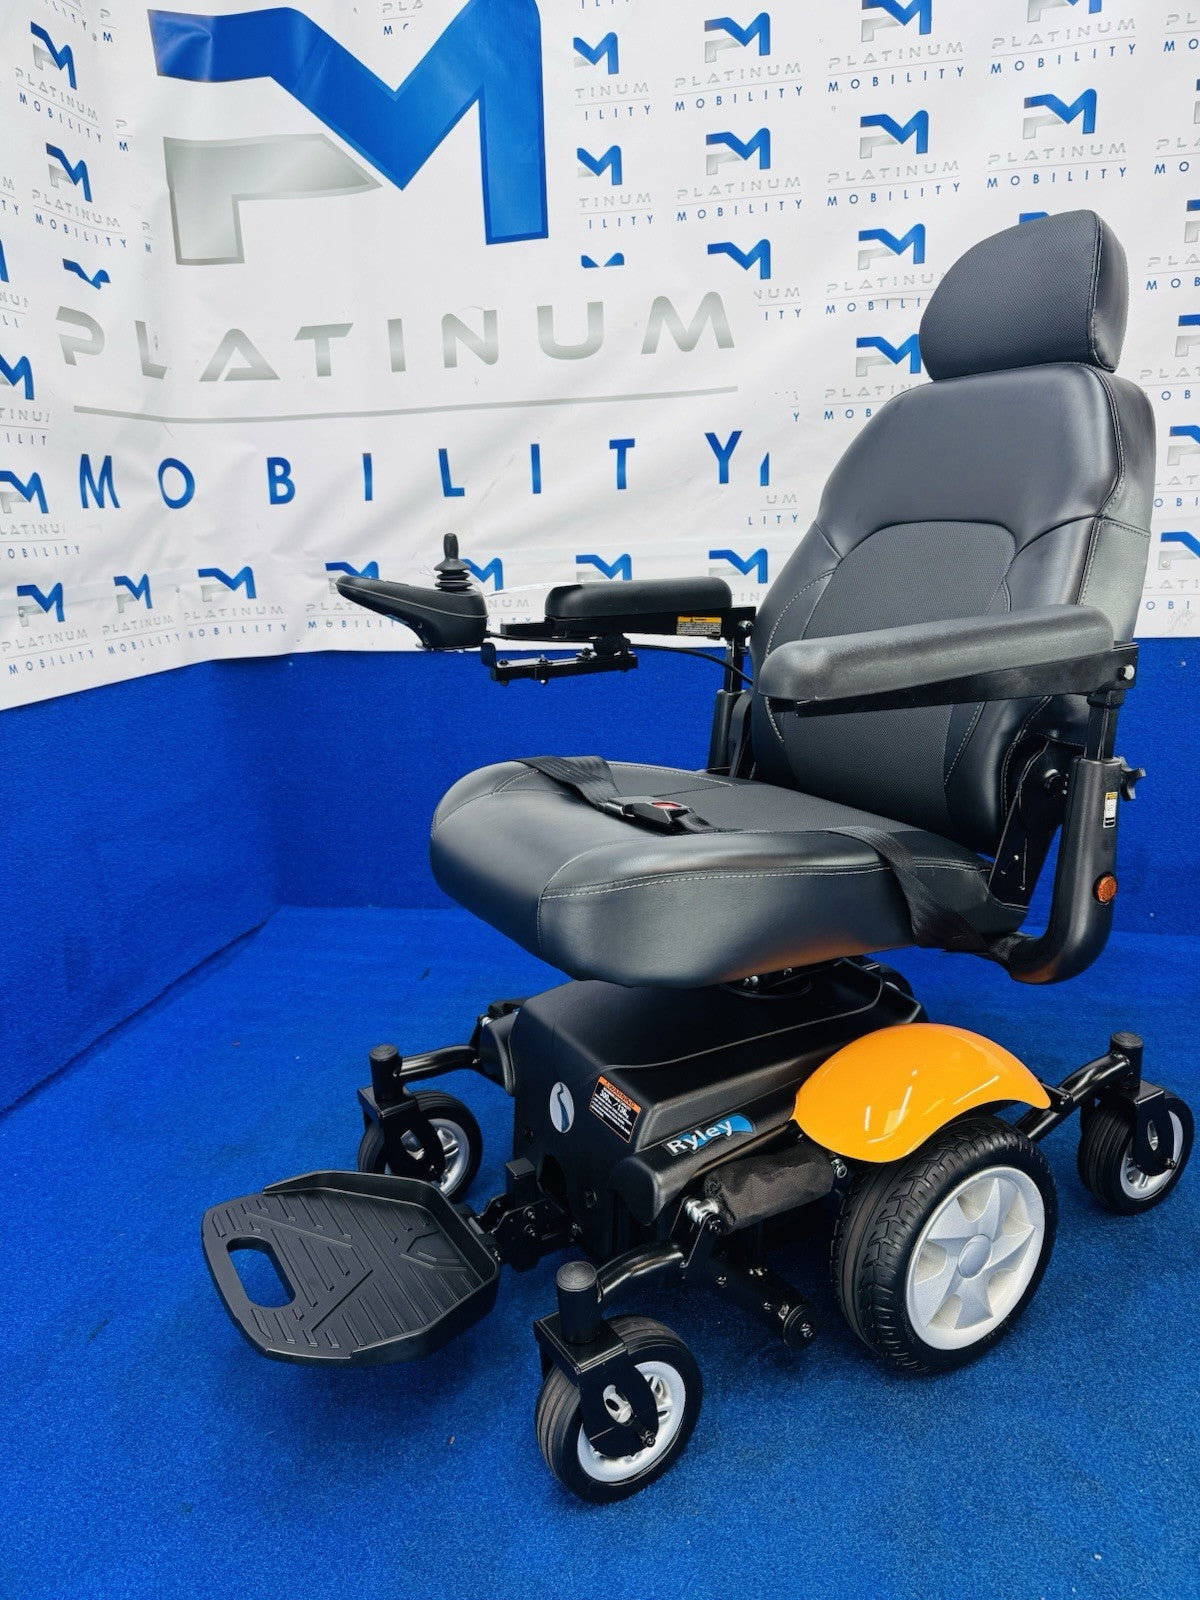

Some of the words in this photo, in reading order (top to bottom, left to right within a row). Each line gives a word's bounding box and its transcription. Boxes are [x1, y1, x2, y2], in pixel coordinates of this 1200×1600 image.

[991, 17, 1136, 50] PLATINUM
[828, 41, 964, 69] PLATINUM
[990, 44, 1137, 74] MOBILITY
[674, 62, 802, 88] PLATINUM
[828, 66, 964, 92] MOBILITY
[15, 67, 98, 121] PLATINUM
[575, 81, 649, 99] TINUM
[674, 86, 803, 111] MOBILITY
[19, 92, 101, 143] MOBILITY
[585, 105, 651, 121] ILITY
[988, 142, 1127, 165] PLATINUM
[827, 160, 960, 183] PLATINUM
[986, 166, 1127, 188] MOBILITY
[676, 176, 801, 200] PLATINUM
[827, 182, 960, 206] MOBILITY
[32, 188, 120, 228] PLATINUM
[579, 192, 652, 208] TINUM
[676, 199, 802, 222] MOBILITY
[35, 213, 128, 248] MOBILITY
[589, 214, 653, 229] ILITY
[826, 272, 945, 293] PLATINU
[764, 308, 802, 321] ITY
[55, 290, 736, 382] PLATINUM
[79, 430, 743, 510] MOBILITY
[748, 514, 798, 525] LITY
[184, 605, 284, 621] PLATINUM
[102, 615, 174, 635] PLATINUM
[188, 623, 287, 639] MOBILITY
[0, 628, 88, 651] PLATINUM
[107, 632, 180, 655] MOBILITY
[8, 649, 94, 675] MOBILITY
[666, 1119, 734, 1154] Ryley
